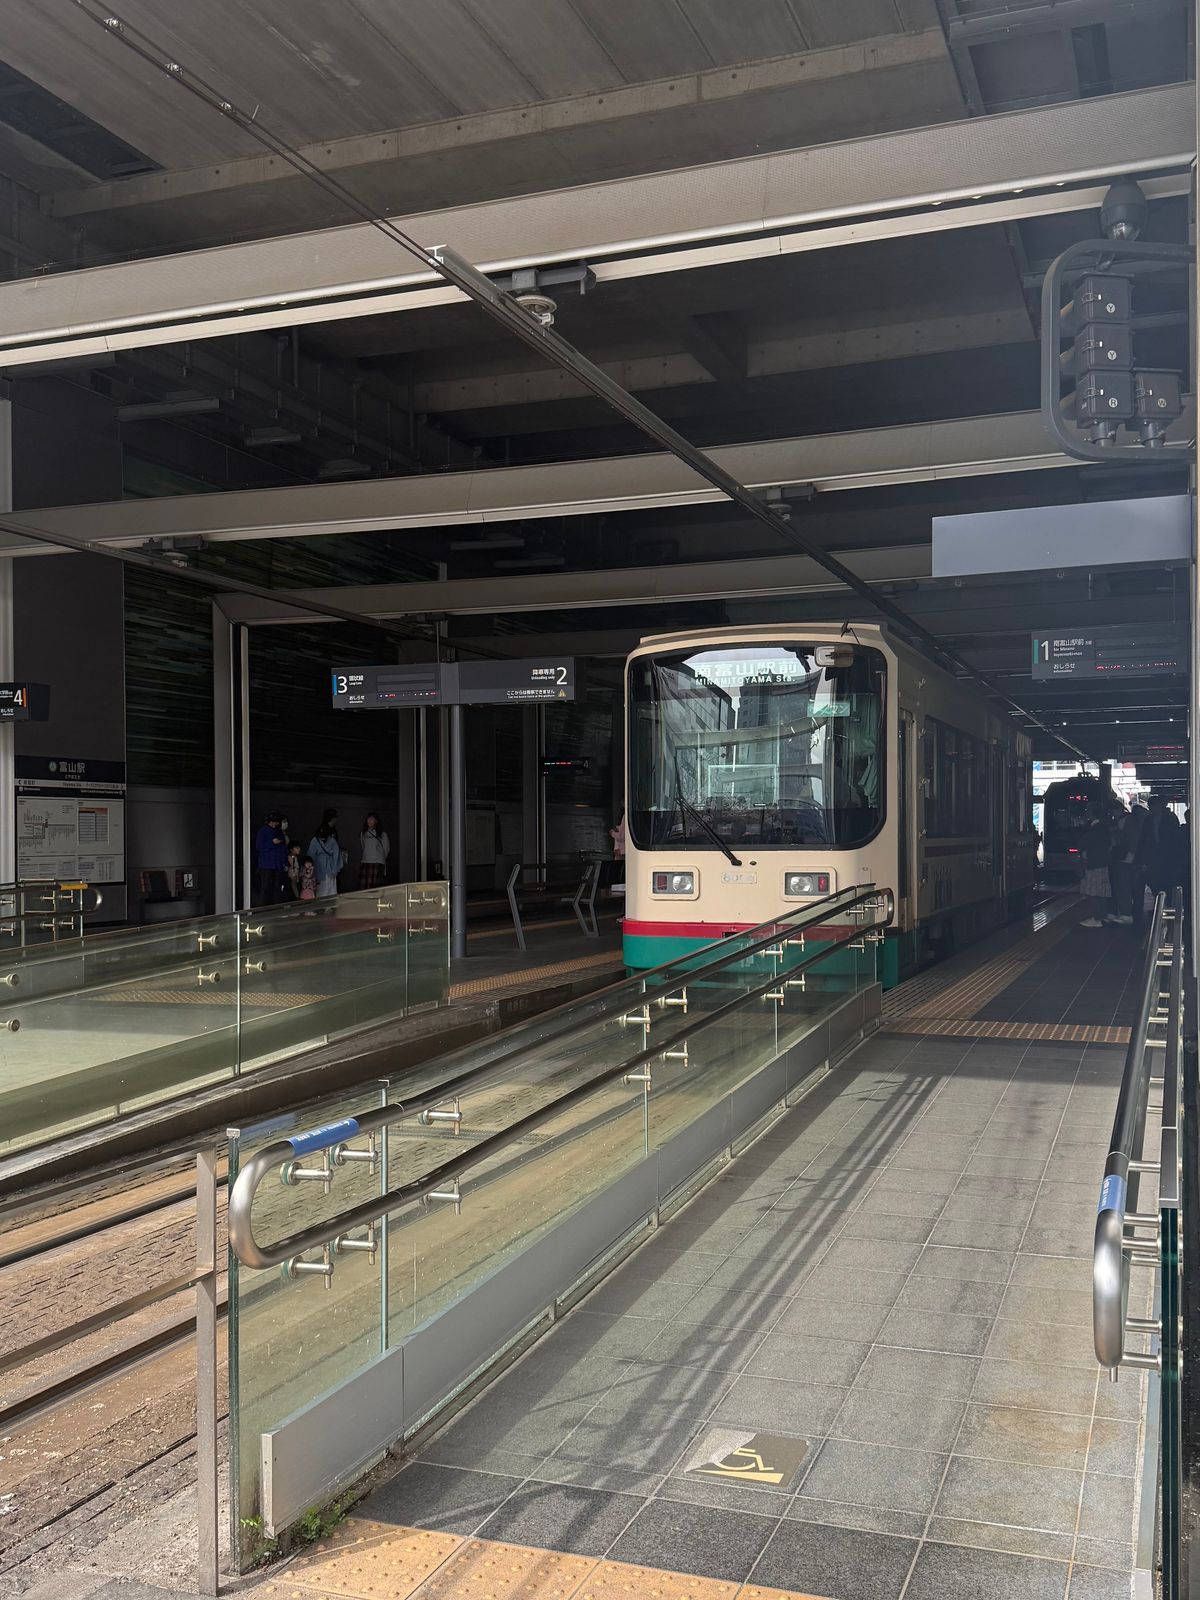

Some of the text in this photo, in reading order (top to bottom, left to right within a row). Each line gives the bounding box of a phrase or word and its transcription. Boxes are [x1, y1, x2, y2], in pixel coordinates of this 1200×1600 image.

[1041, 640, 1049, 661] 1
[556, 666, 568, 685] 2
[695, 674, 796, 686] MINAMITOYAMA Sta.
[337, 676, 348, 694] 3
[13, 689, 24, 706] 4
[59, 761, 86, 774] 富山駅
